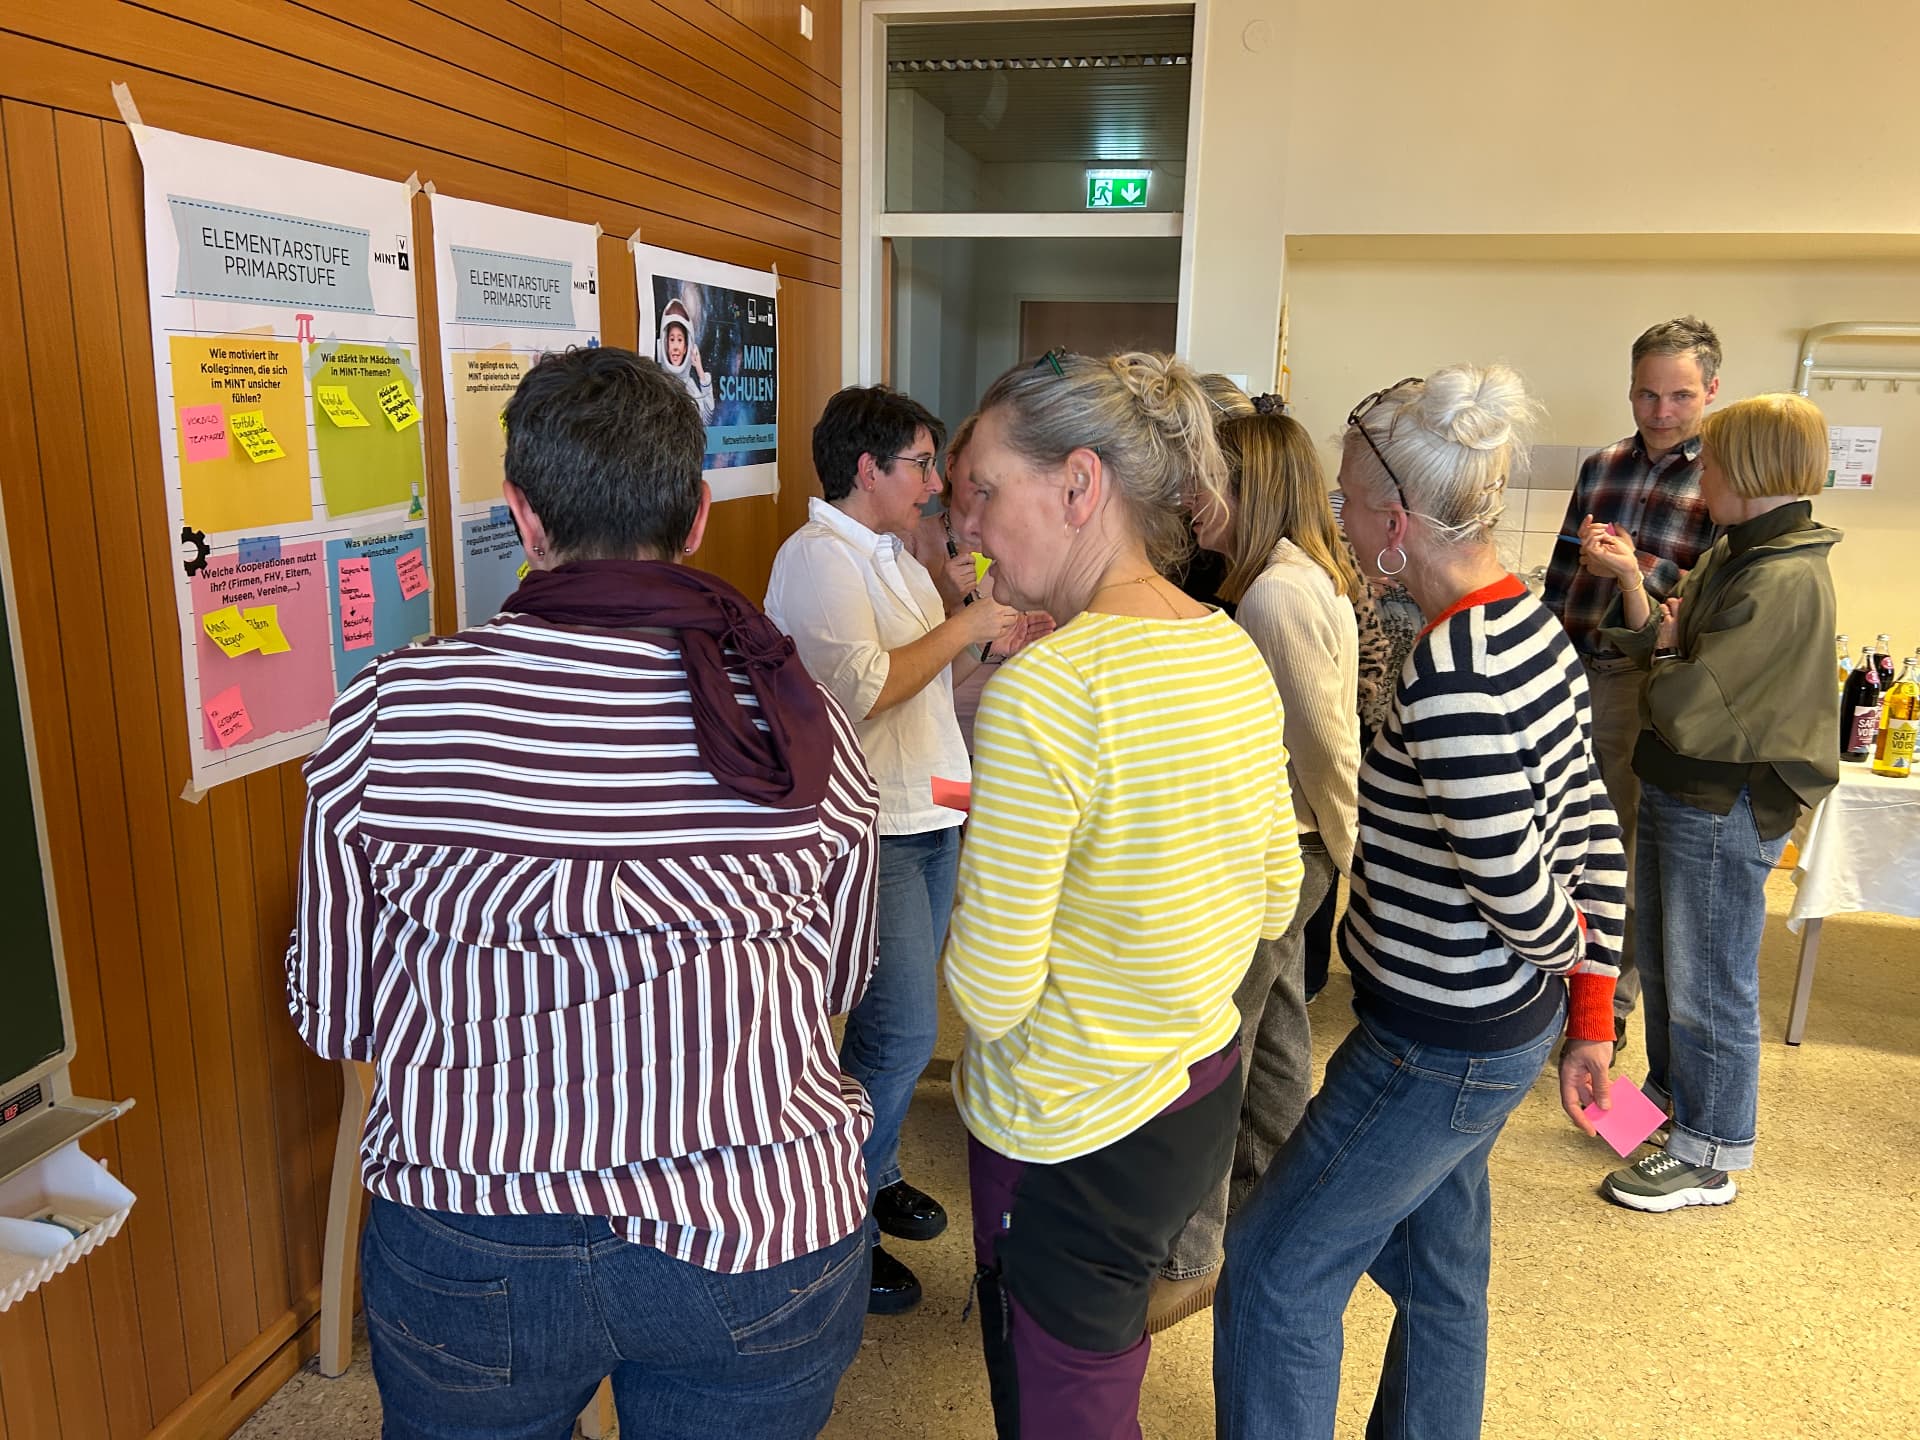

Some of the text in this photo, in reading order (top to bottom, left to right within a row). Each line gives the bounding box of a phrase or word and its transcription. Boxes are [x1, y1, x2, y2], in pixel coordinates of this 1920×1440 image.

[201, 227, 351, 266] ELEMENTARSTUFE
[374, 251, 396, 264] MINT
[224, 255, 336, 287] PRIMARSTUFE
[470, 269, 561, 294] ELEMENTARSTUFE
[573, 280, 588, 291] MINT
[483, 290, 552, 310] PRIMARSTUFE
[209, 348, 279, 361] Wie motiviert ihr
[320, 352, 400, 365] Wie stärkt ihr Mädchen
[743, 344, 773, 371] MINT
[200, 363, 288, 375] Kolleg:innen, die sich
[330, 366, 391, 377] in MINT-Themen?
[467, 361, 479, 369] Wie
[468, 372, 481, 380] MINT
[211, 378, 281, 389] im MINT unsicher
[719, 375, 774, 401] SCHULEN
[232, 392, 262, 403] fühlen?
[344, 532, 414, 549] Was würdet ihr euch
[362, 545, 399, 558] wünschen?
[201, 552, 317, 579] Welche Kooperationen nutzt
[210, 567, 312, 593] ihr? (Firmen, FHV, Eltern,
[222, 591, 255, 604] Museen,
[205, 619, 230, 635] MINT
[214, 632, 245, 647] Region
[1858, 719, 1874, 728] SAF
[1892, 731, 1915, 741] SAFT
